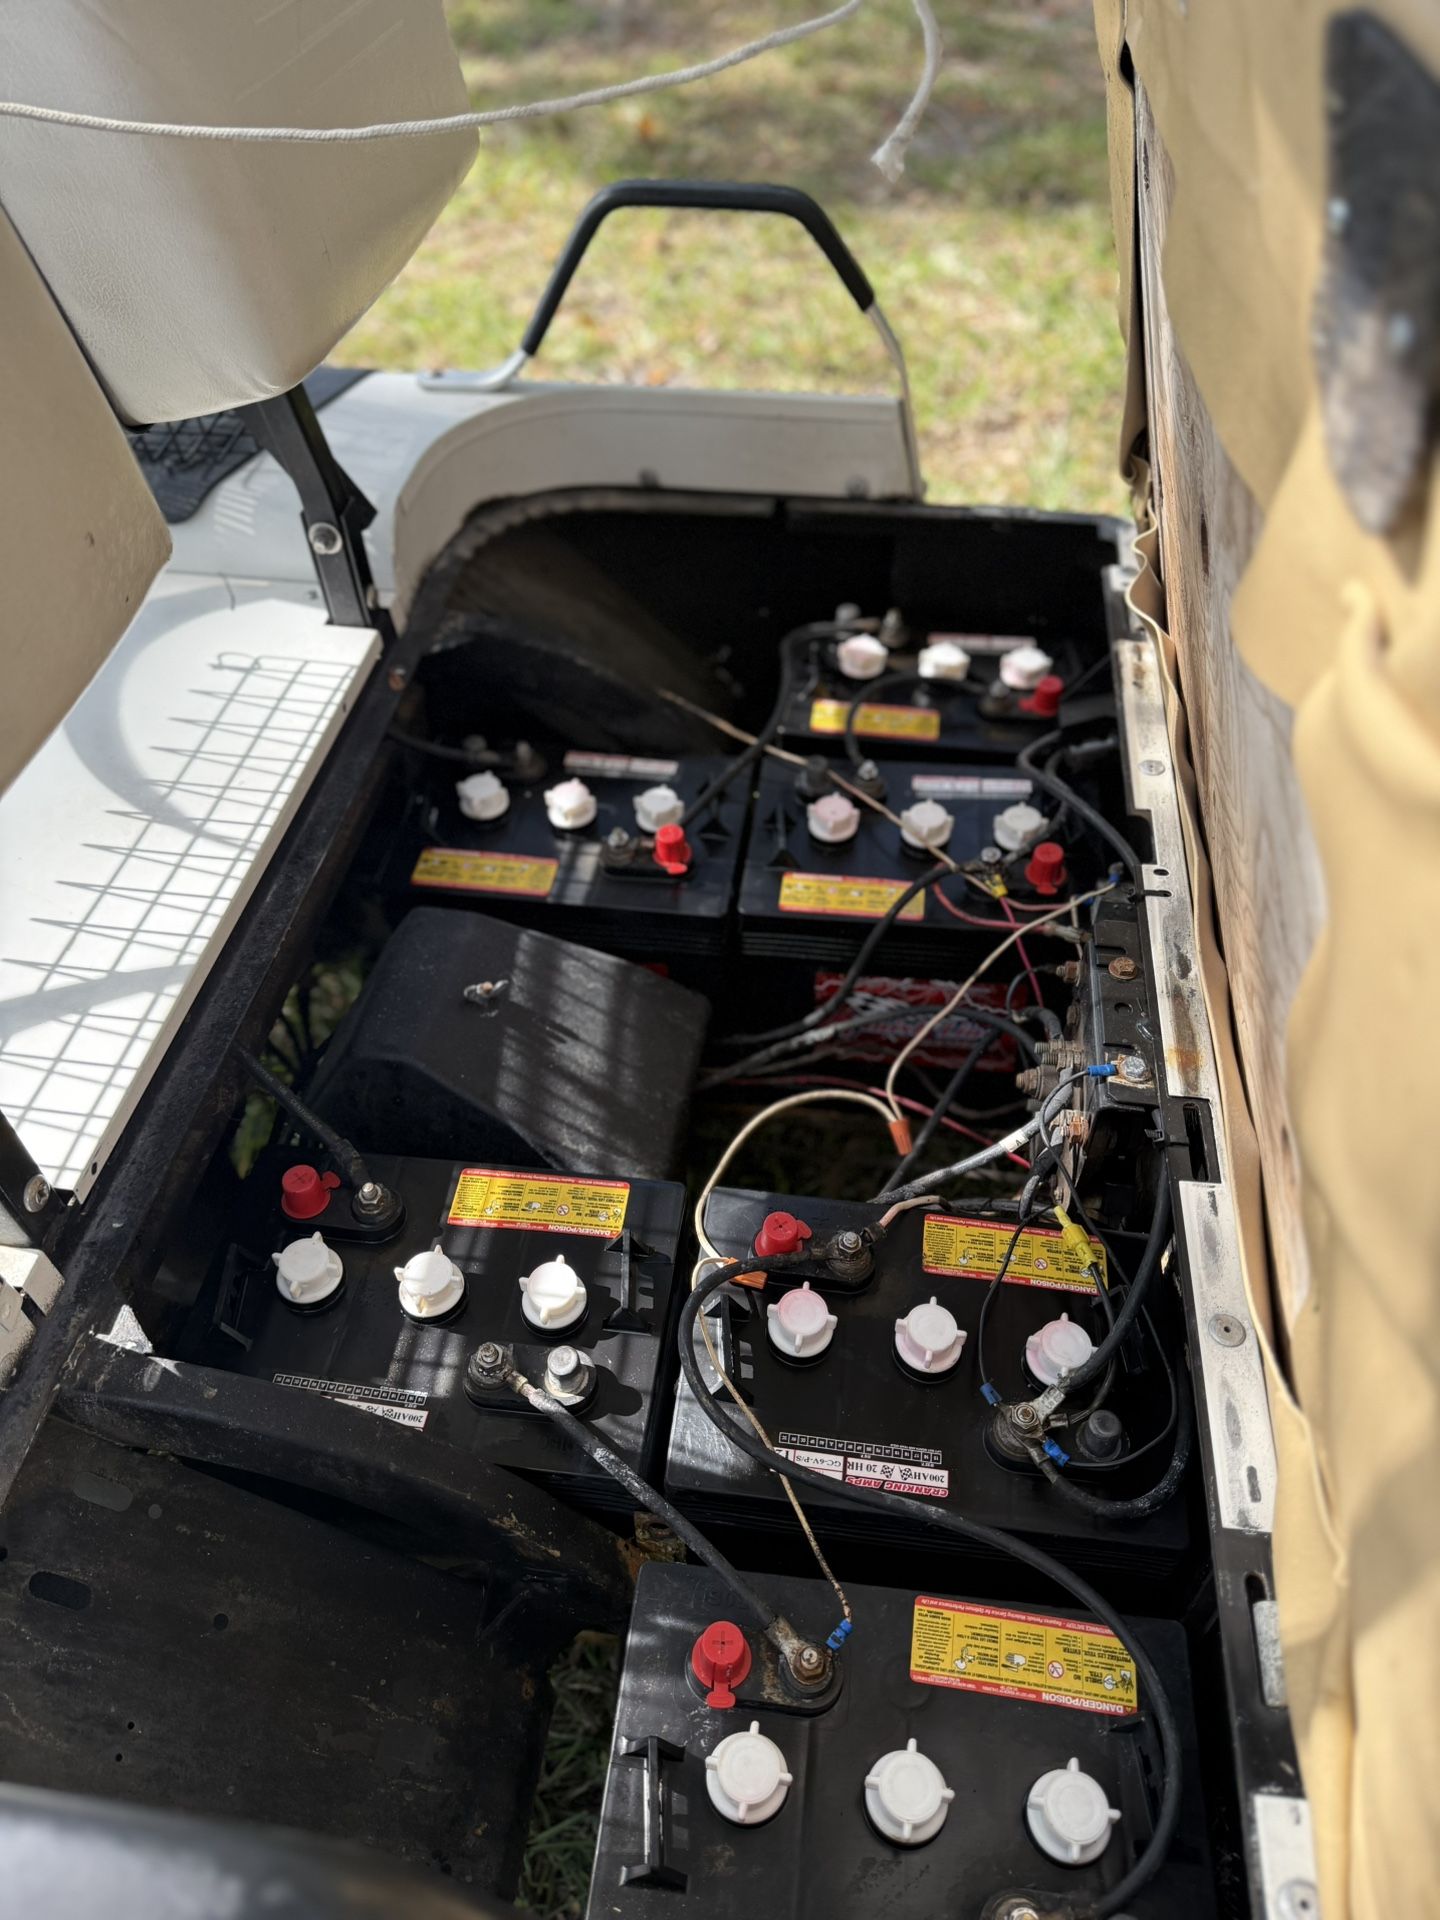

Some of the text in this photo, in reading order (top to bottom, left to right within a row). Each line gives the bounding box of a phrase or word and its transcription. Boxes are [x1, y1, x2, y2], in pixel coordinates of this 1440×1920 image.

[548, 1224, 610, 1235] DANGER/POISON
[1030, 1278, 1096, 1293] DANGER/POISON
[796, 1455, 841, 1467] GC-6V-P/S
[847, 1460, 944, 1483] 200AH 20 HR
[846, 1475, 947, 1498] CRANKING AMPS
[1041, 1691, 1123, 1713] DANGER/POISON
